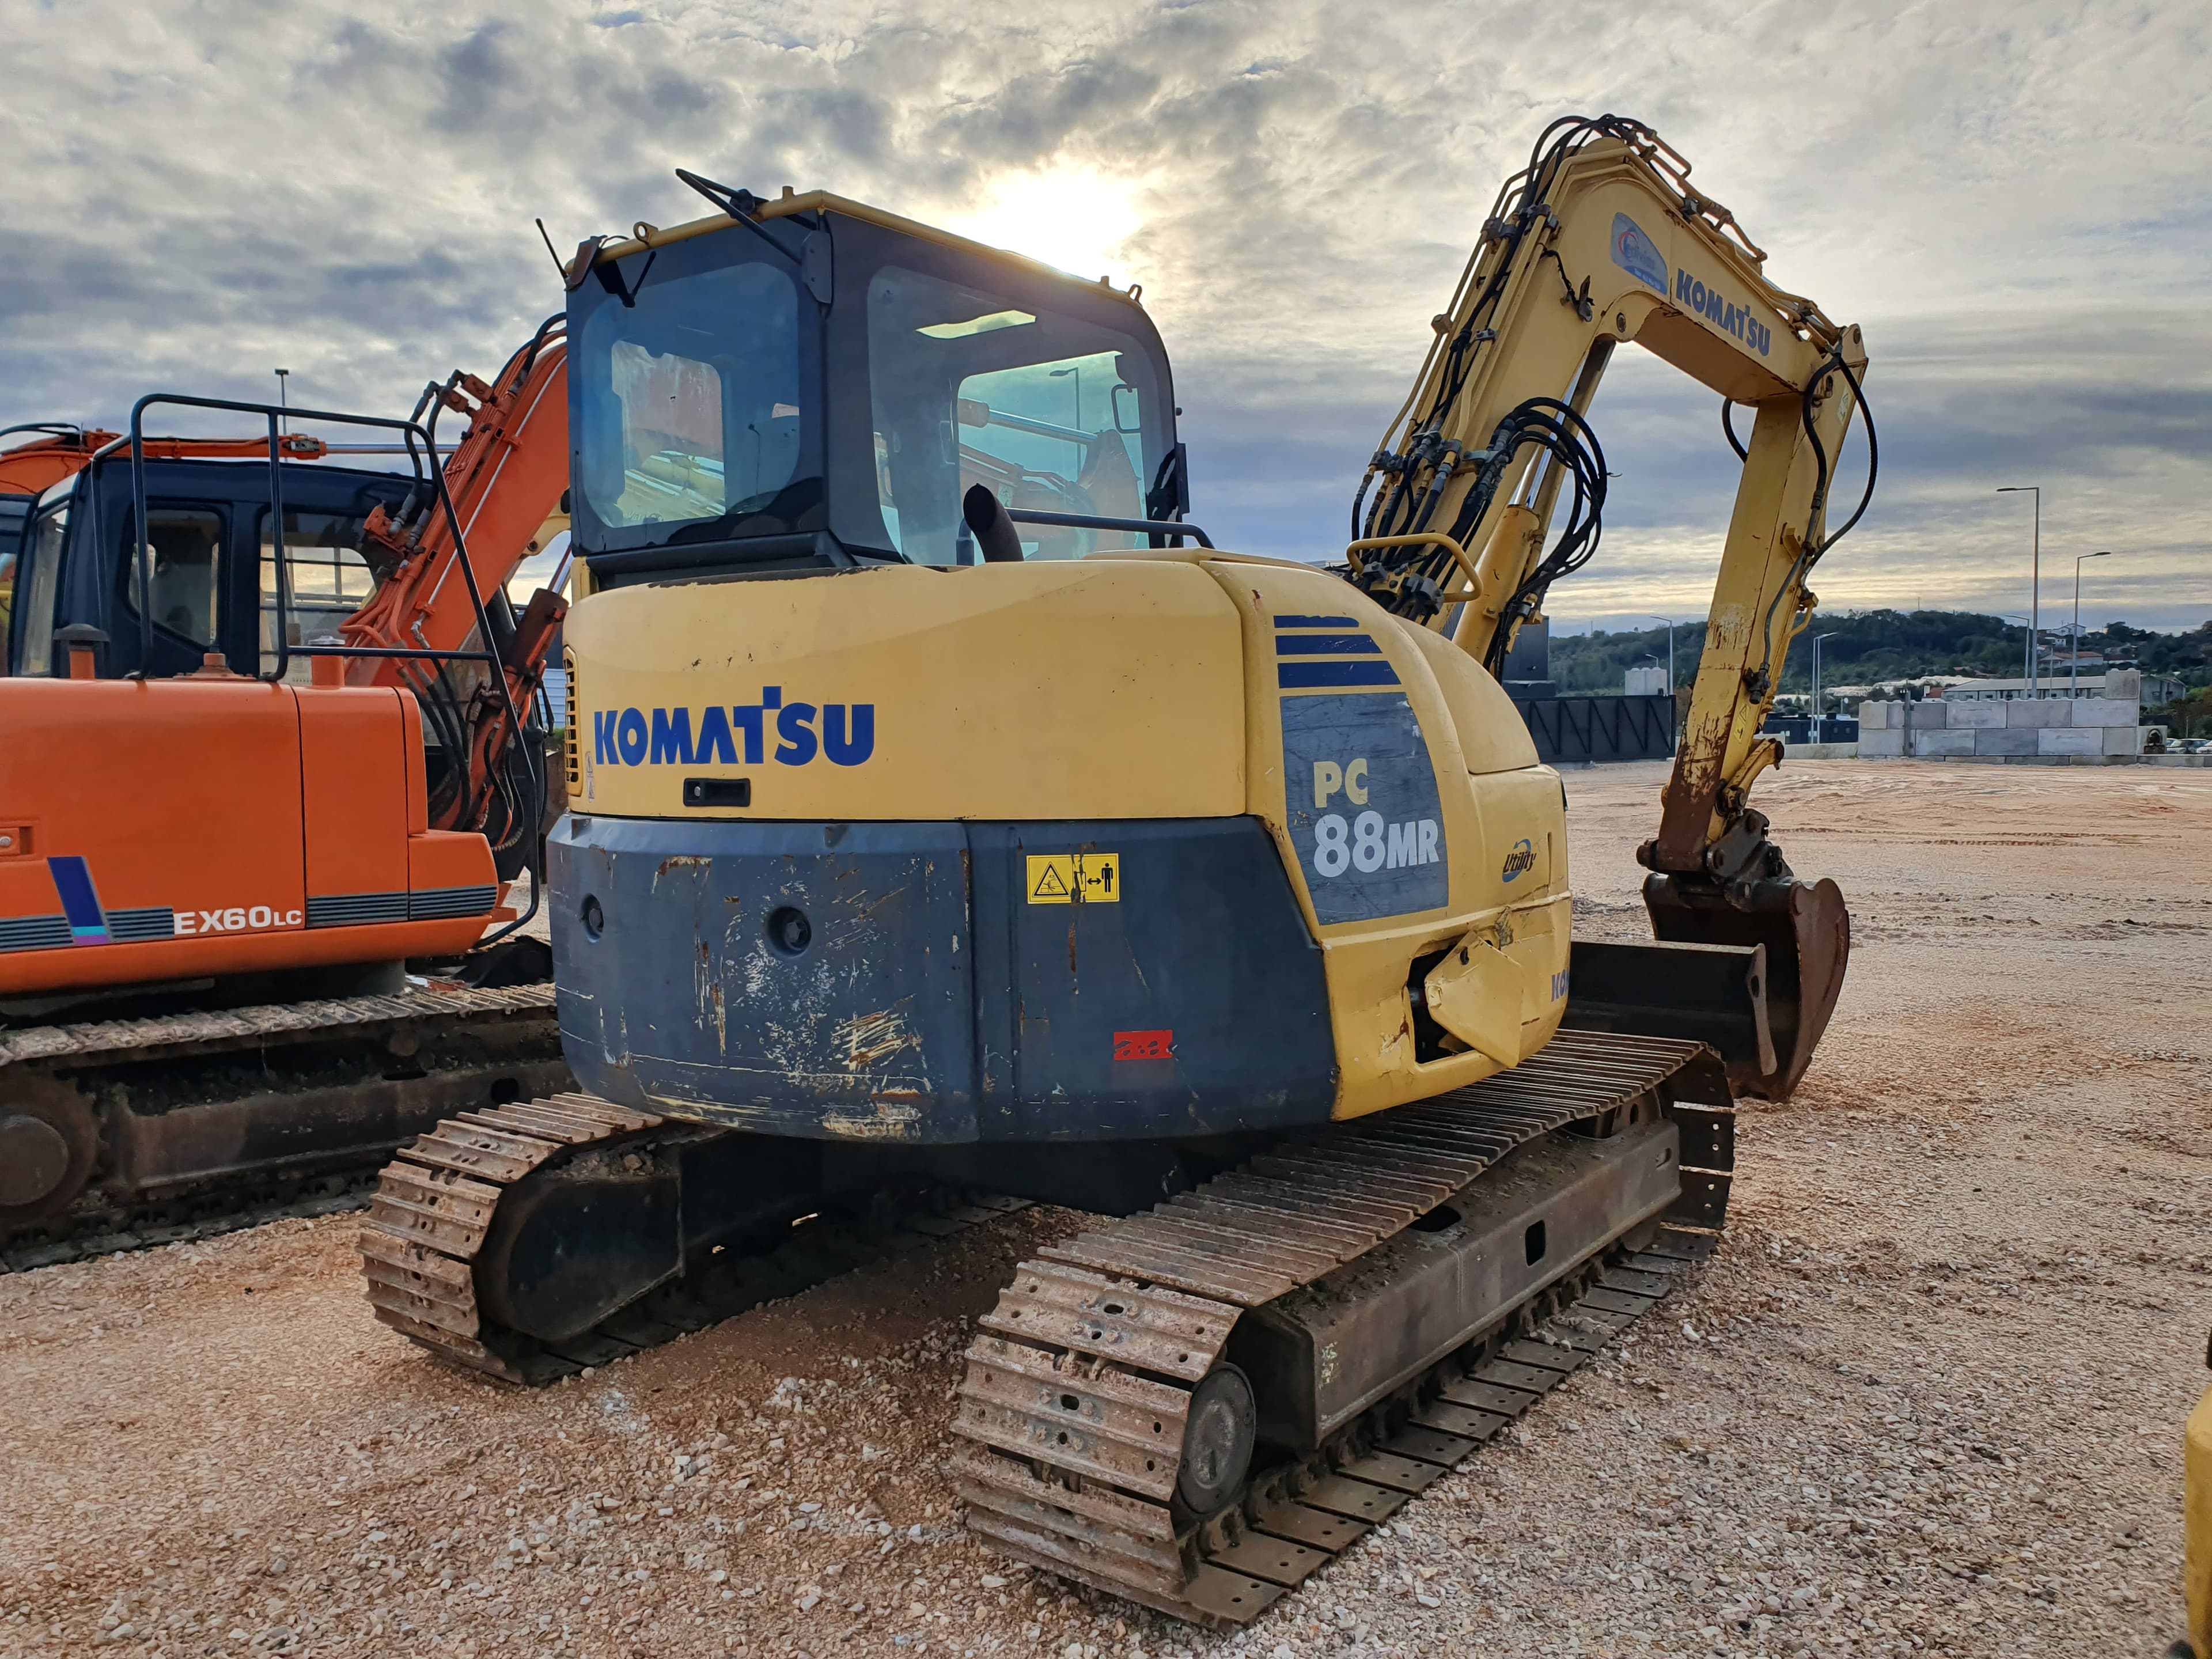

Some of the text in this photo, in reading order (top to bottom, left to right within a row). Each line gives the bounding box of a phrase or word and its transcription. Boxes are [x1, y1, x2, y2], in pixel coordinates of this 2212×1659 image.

[1676, 268, 1771, 357] KOMATSU
[594, 685, 875, 767] KOMATSU
[1313, 757, 1369, 808] PC
[1314, 810, 1440, 878] 88MR
[1502, 851, 1537, 873] Utility
[173, 906, 302, 935] EX60LC
